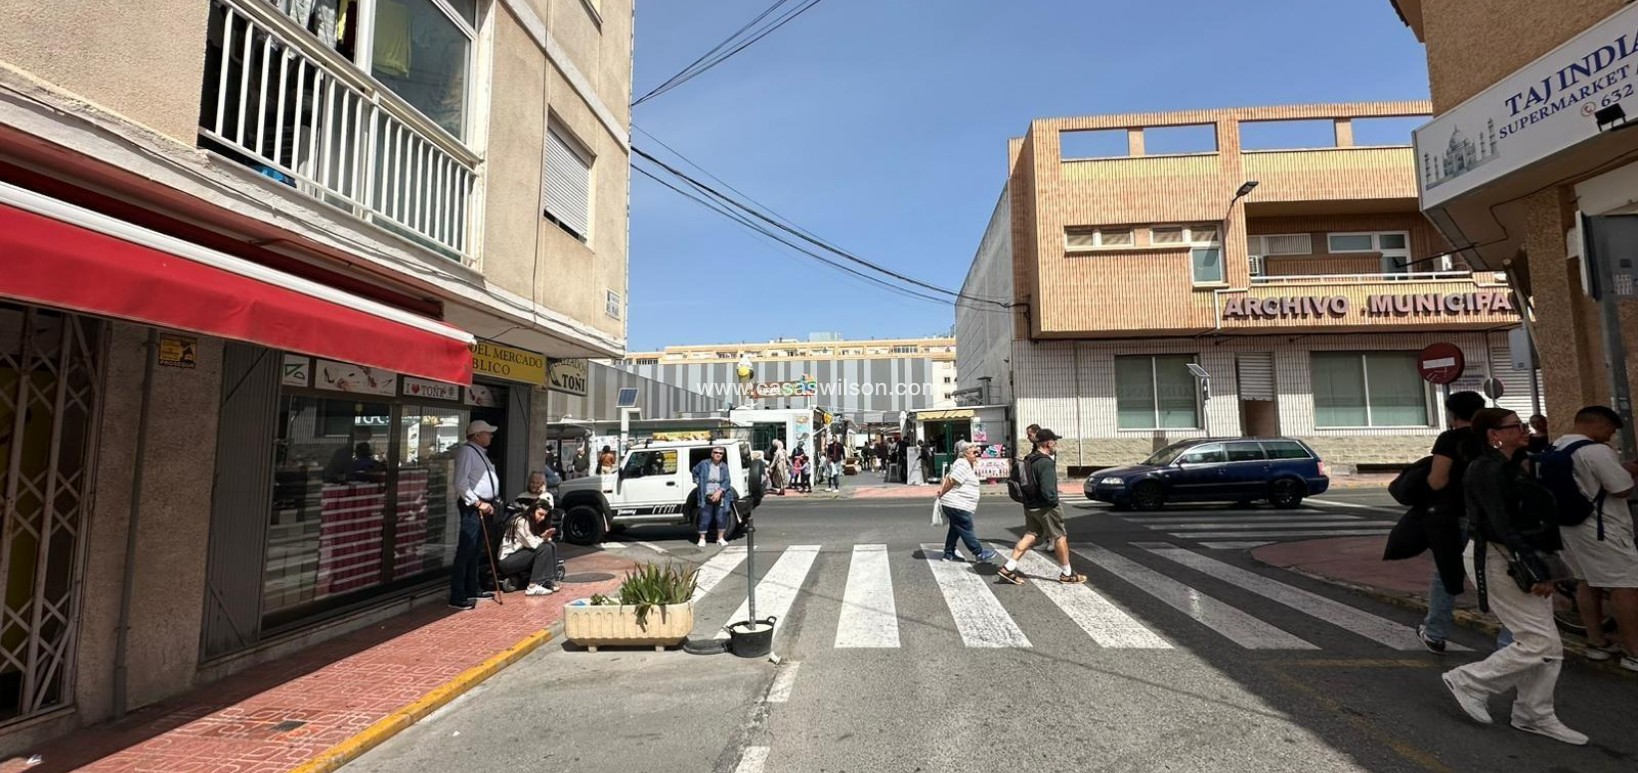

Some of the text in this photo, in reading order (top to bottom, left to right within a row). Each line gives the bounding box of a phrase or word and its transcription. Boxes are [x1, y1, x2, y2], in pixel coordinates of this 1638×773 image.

[1499, 64, 1630, 139] SUPERMARKET
[1505, 76, 1552, 117] TAJ
[1222, 293, 1515, 319] ARCHIVO MUNICIPA
[472, 358, 511, 376] BLICO
[493, 348, 543, 368] MERCADO
[562, 373, 586, 392] TOÑI
